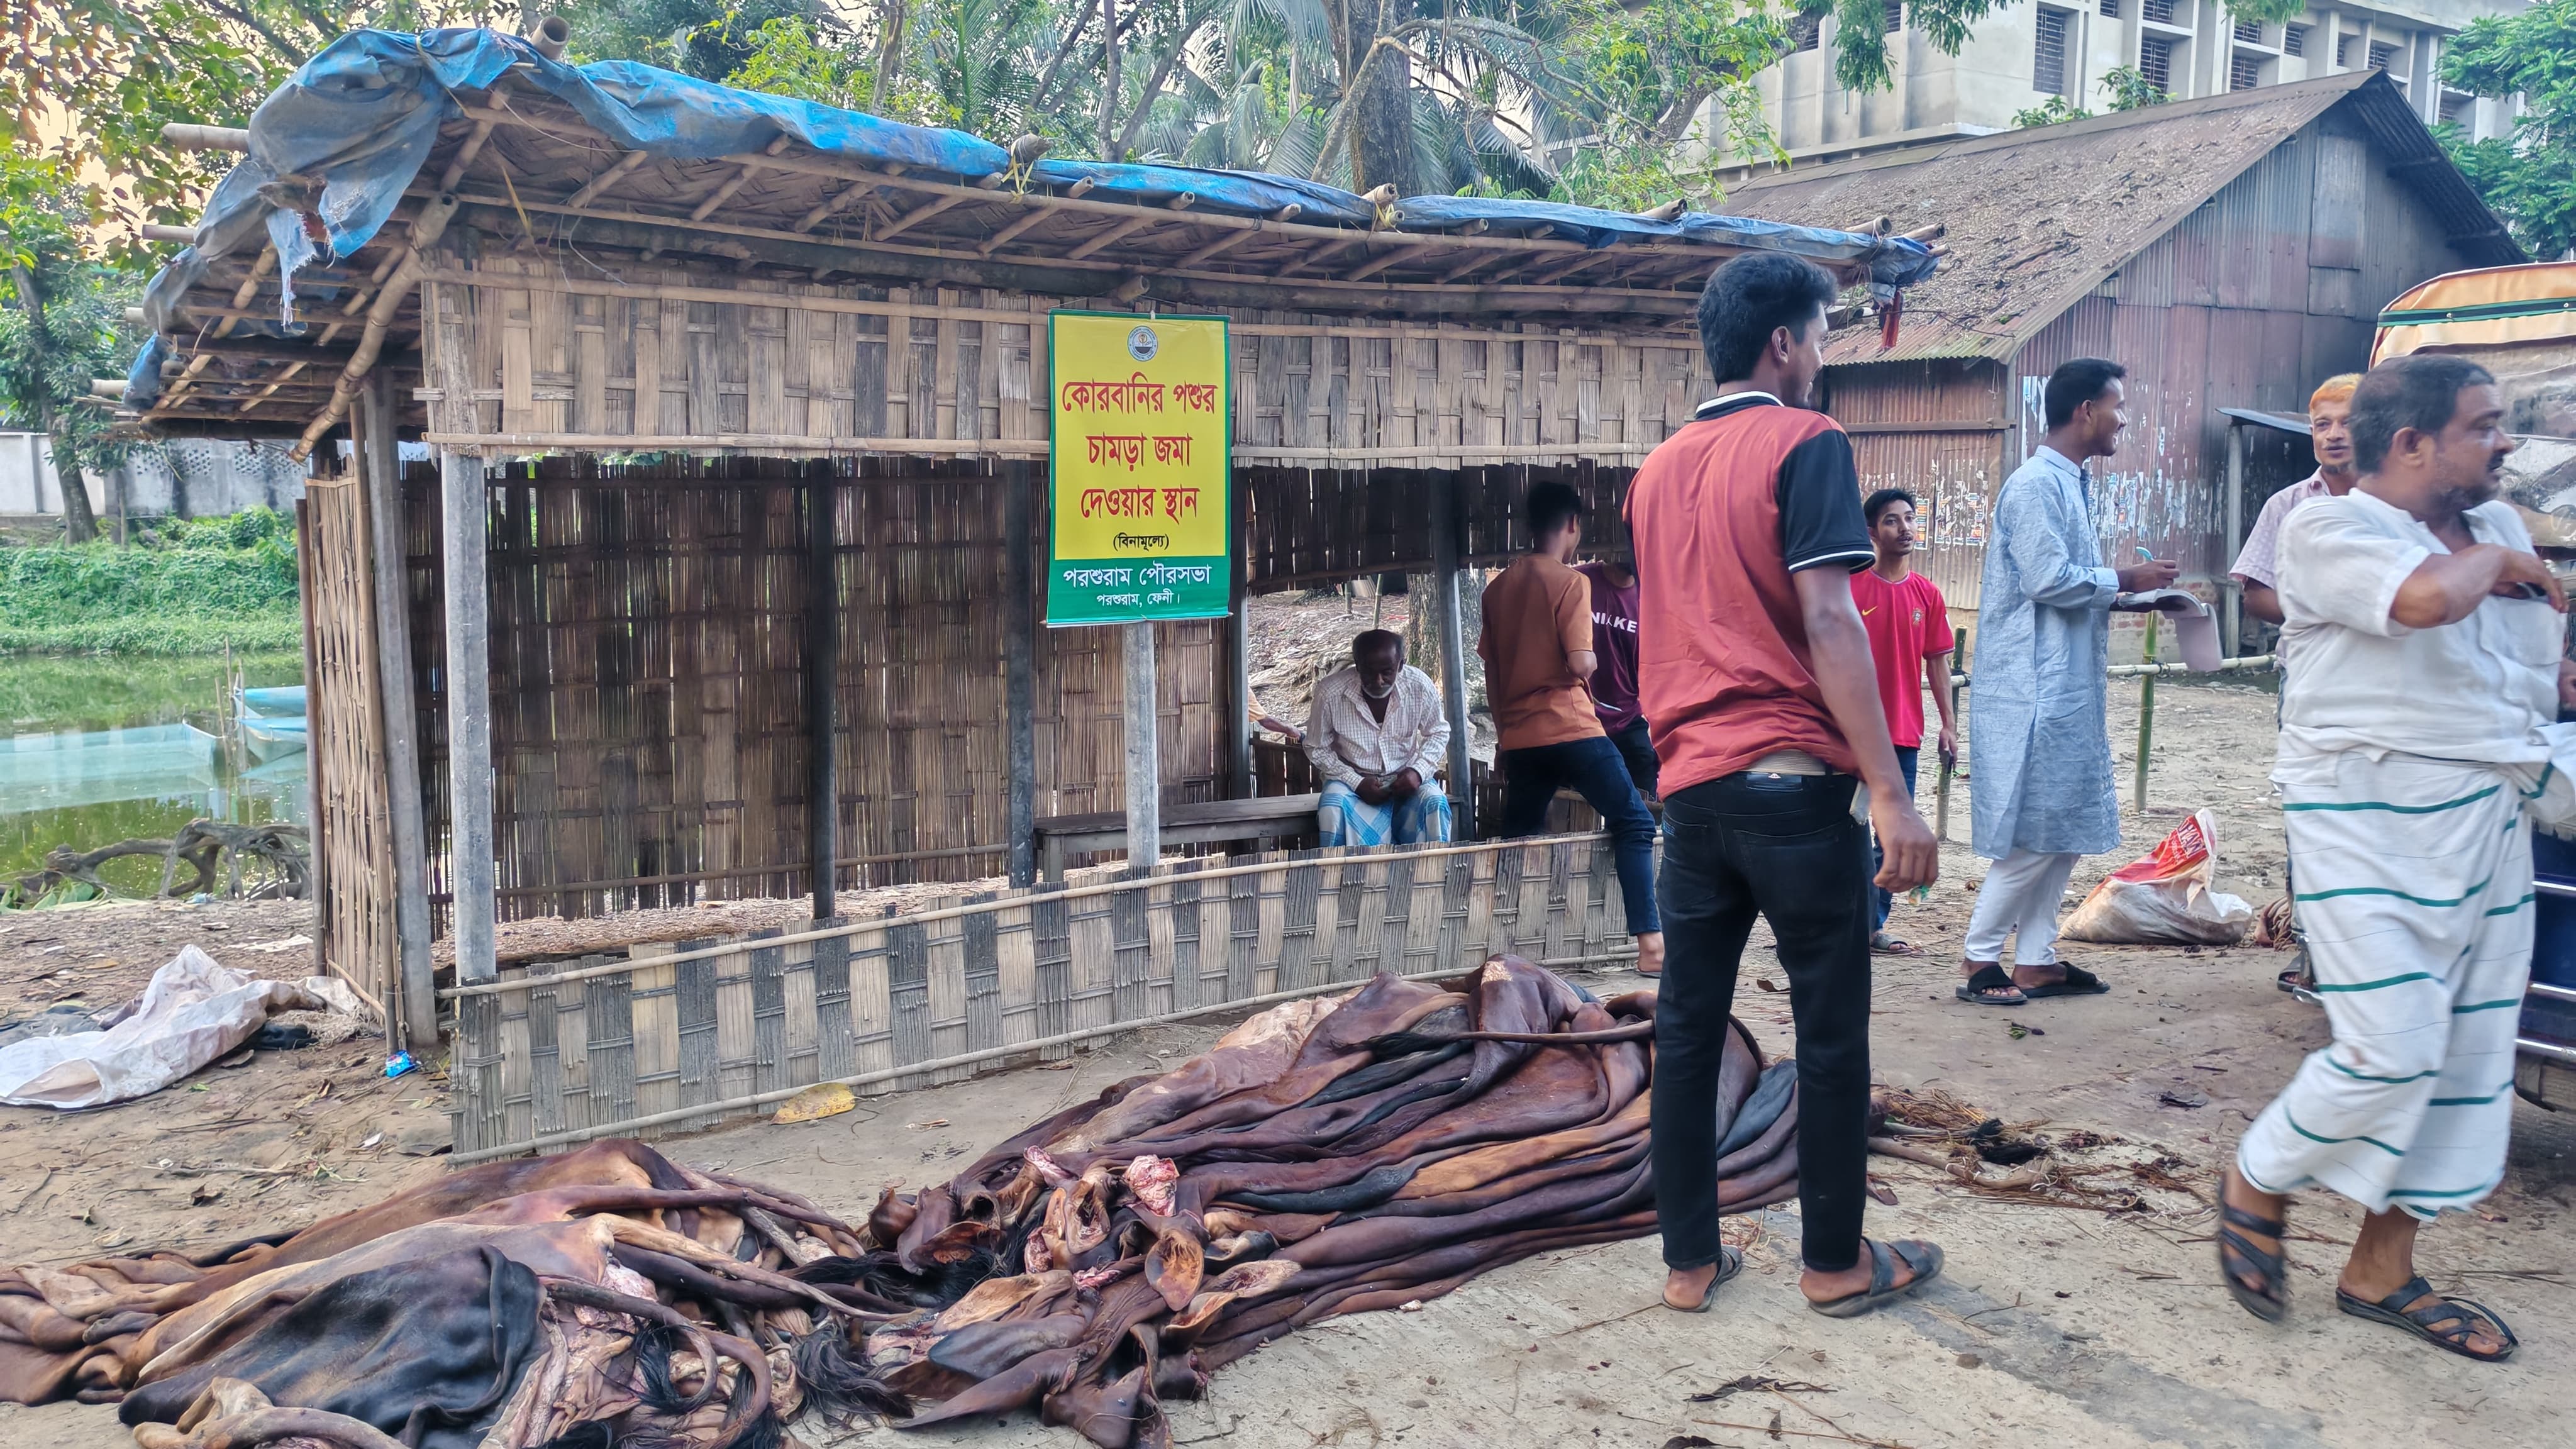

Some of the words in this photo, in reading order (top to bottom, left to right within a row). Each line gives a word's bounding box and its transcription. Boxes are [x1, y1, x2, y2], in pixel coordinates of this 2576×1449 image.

[1062, 371, 1165, 413] কোরবানির
[1173, 380, 1218, 414] পশুর
[1085, 432, 1147, 472] চামড়া
[1152, 436, 1193, 467] জমা
[1080, 484, 1157, 519] দেওয়ার
[1161, 487, 1200, 525] স্থান
[1113, 532, 1169, 551] (বিনামূল্যে)
[1063, 567, 1133, 588] পরশুরাম
[1139, 560, 1212, 586] পৌরসভা
[1096, 592, 1143, 608] পরশুরাম,
